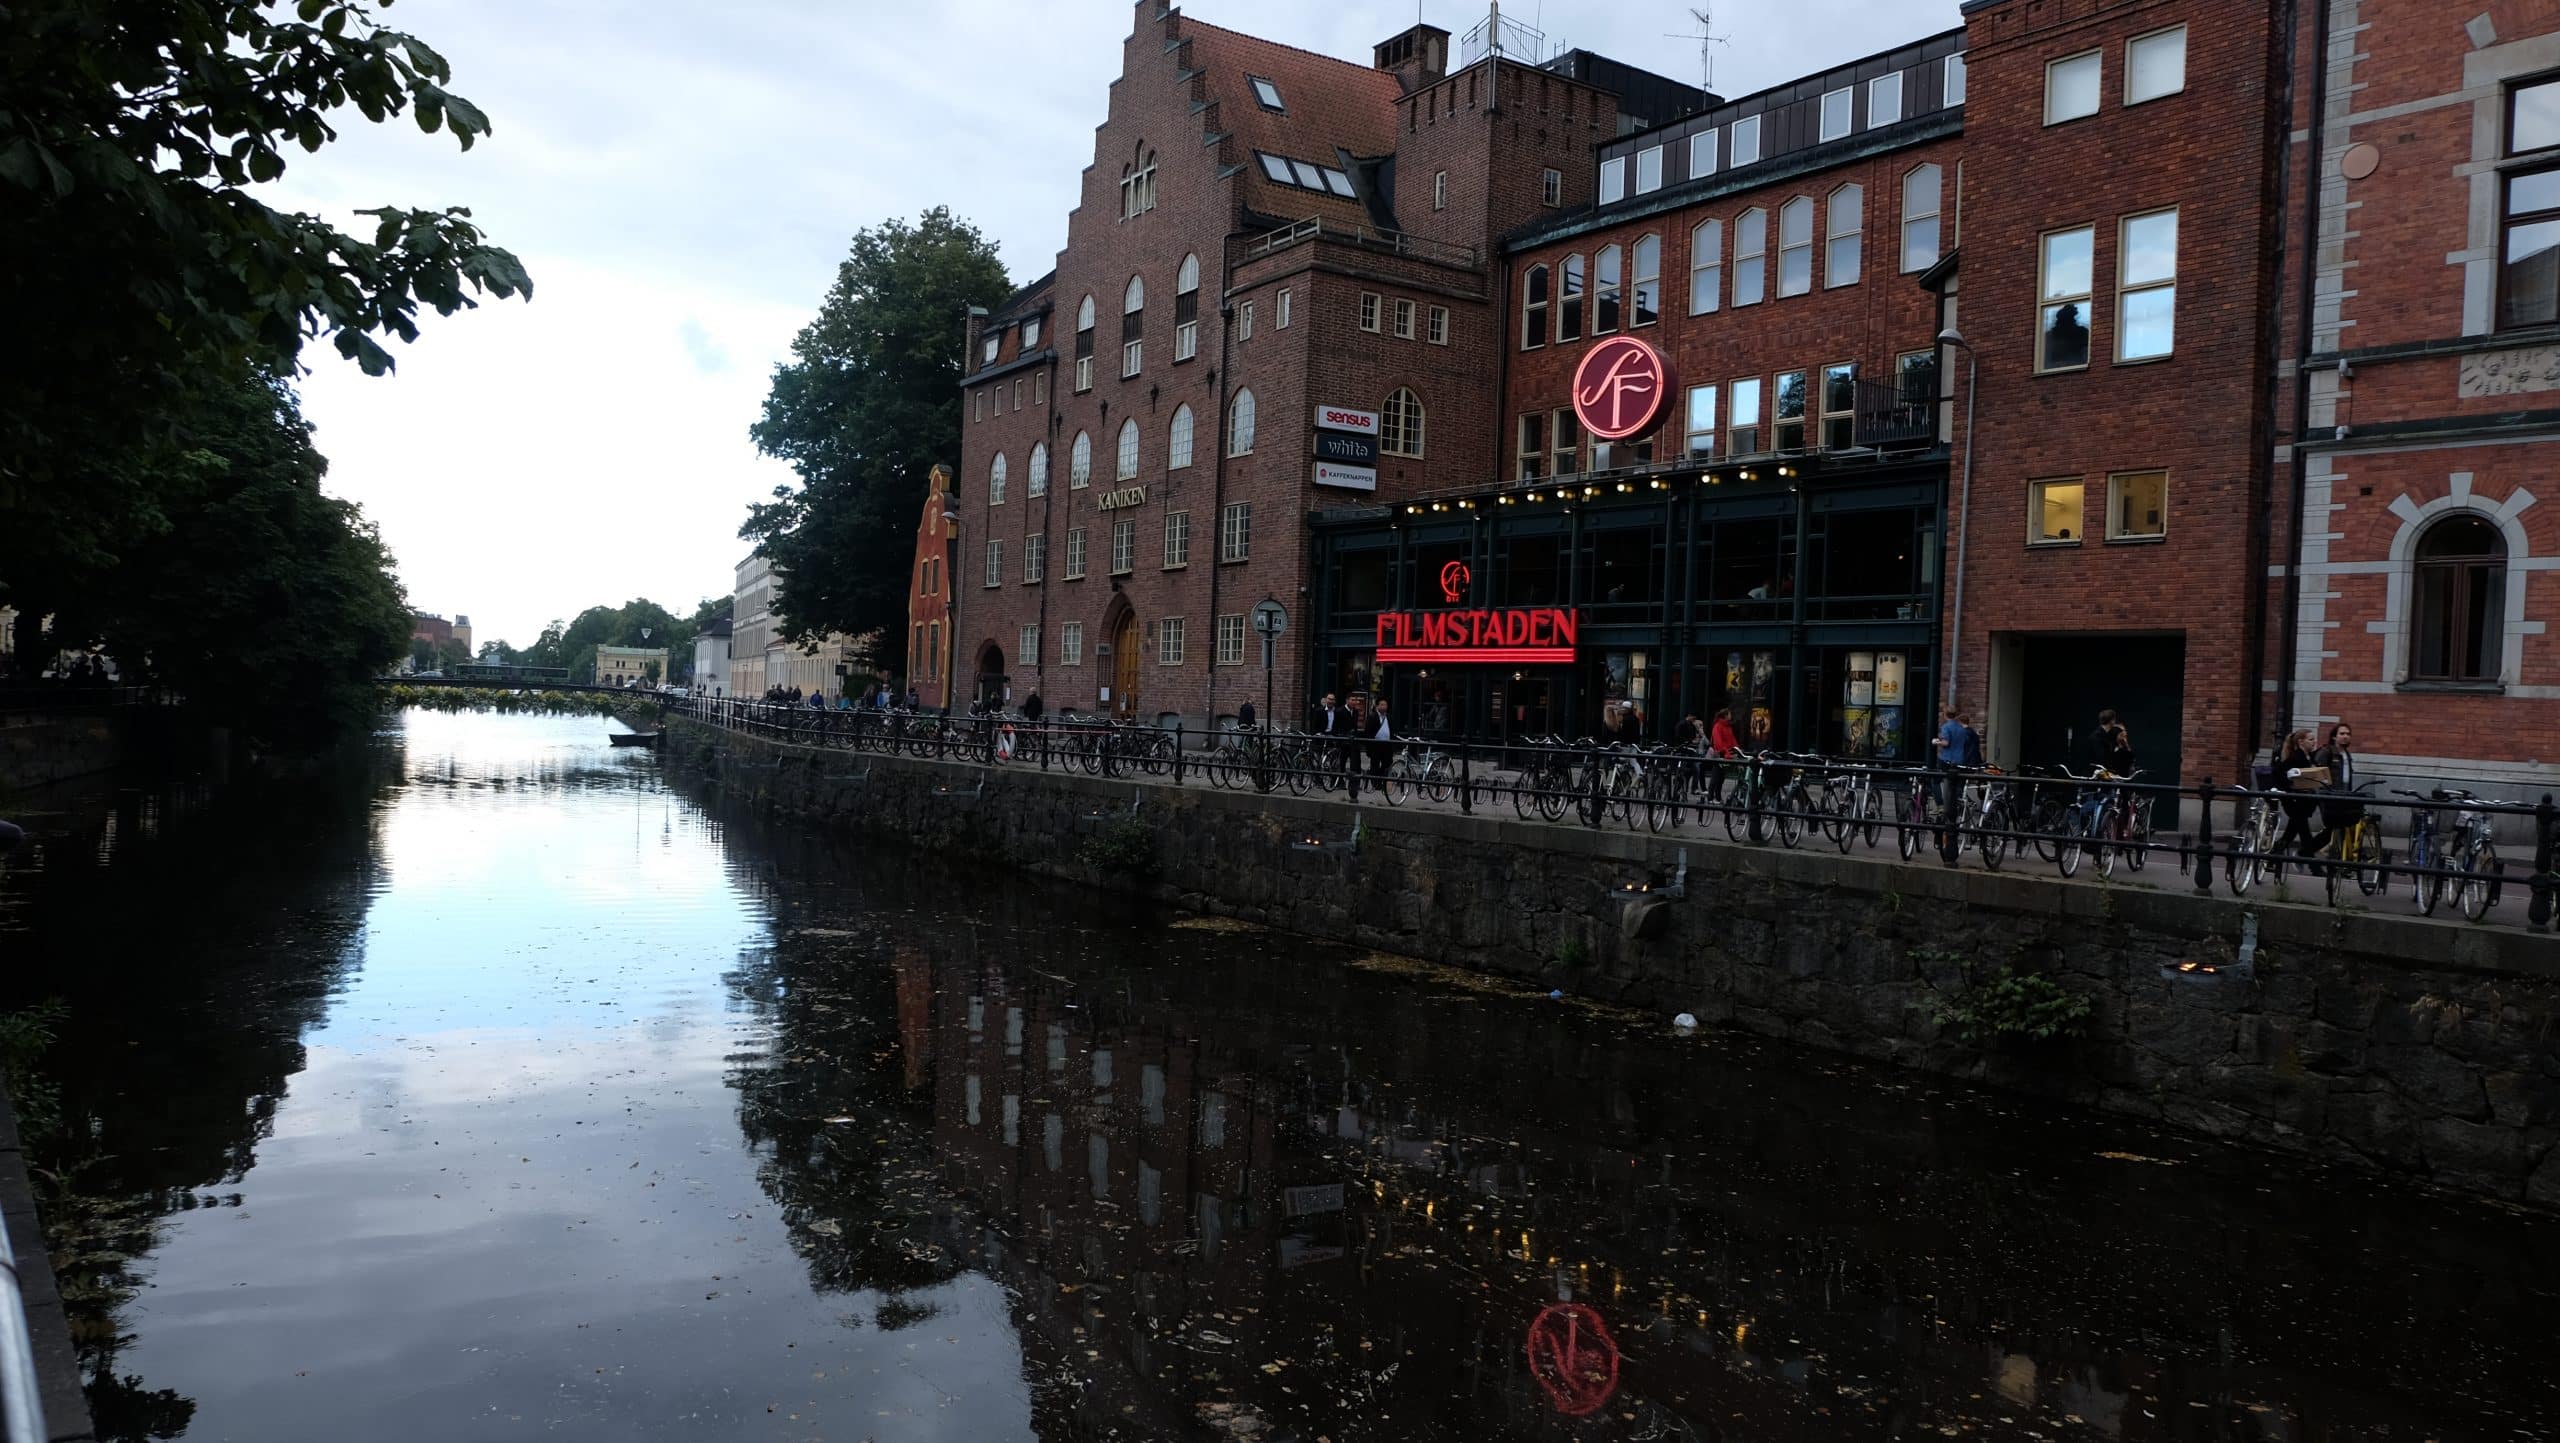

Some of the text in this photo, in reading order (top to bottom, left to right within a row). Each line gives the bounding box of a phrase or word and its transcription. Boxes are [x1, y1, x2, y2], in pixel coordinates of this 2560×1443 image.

[1580, 349, 1655, 429] SF
[1326, 411, 1371, 428] sensus
[1328, 471, 1373, 484] KAFFEKNAPPEN
[1098, 485, 1148, 512] KANIKEN
[1376, 608, 1578, 647] FILMSTADEN
